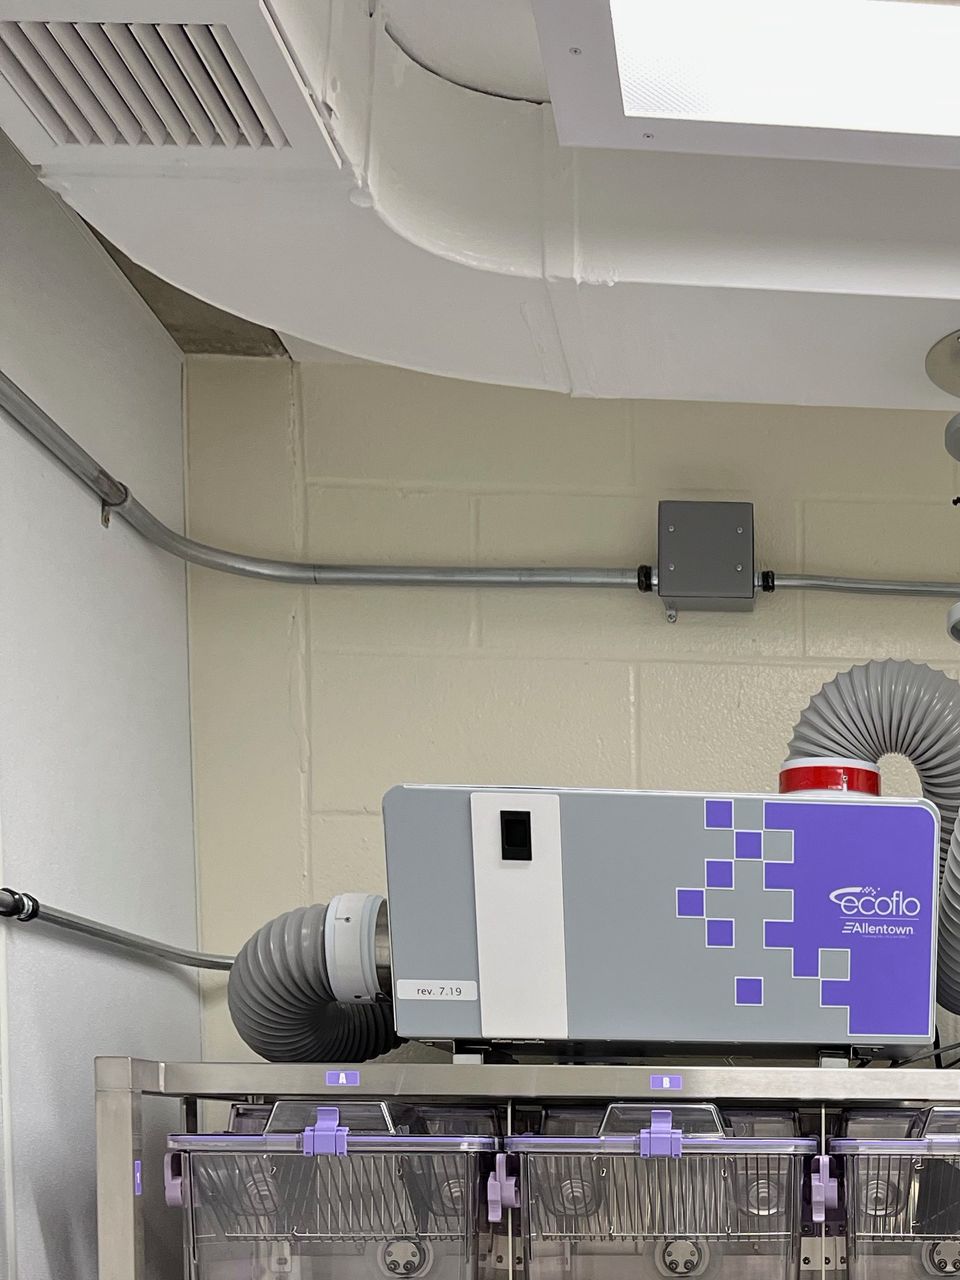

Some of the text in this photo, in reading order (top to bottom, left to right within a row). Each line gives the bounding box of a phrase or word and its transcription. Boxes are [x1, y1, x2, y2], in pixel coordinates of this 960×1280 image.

[835, 888, 921, 916] ecoflo
[852, 922, 914, 935] Allentown
[416, 986, 462, 996] rev. 7.19
[338, 1072, 347, 1084] A
[662, 1077, 670, 1088] B
